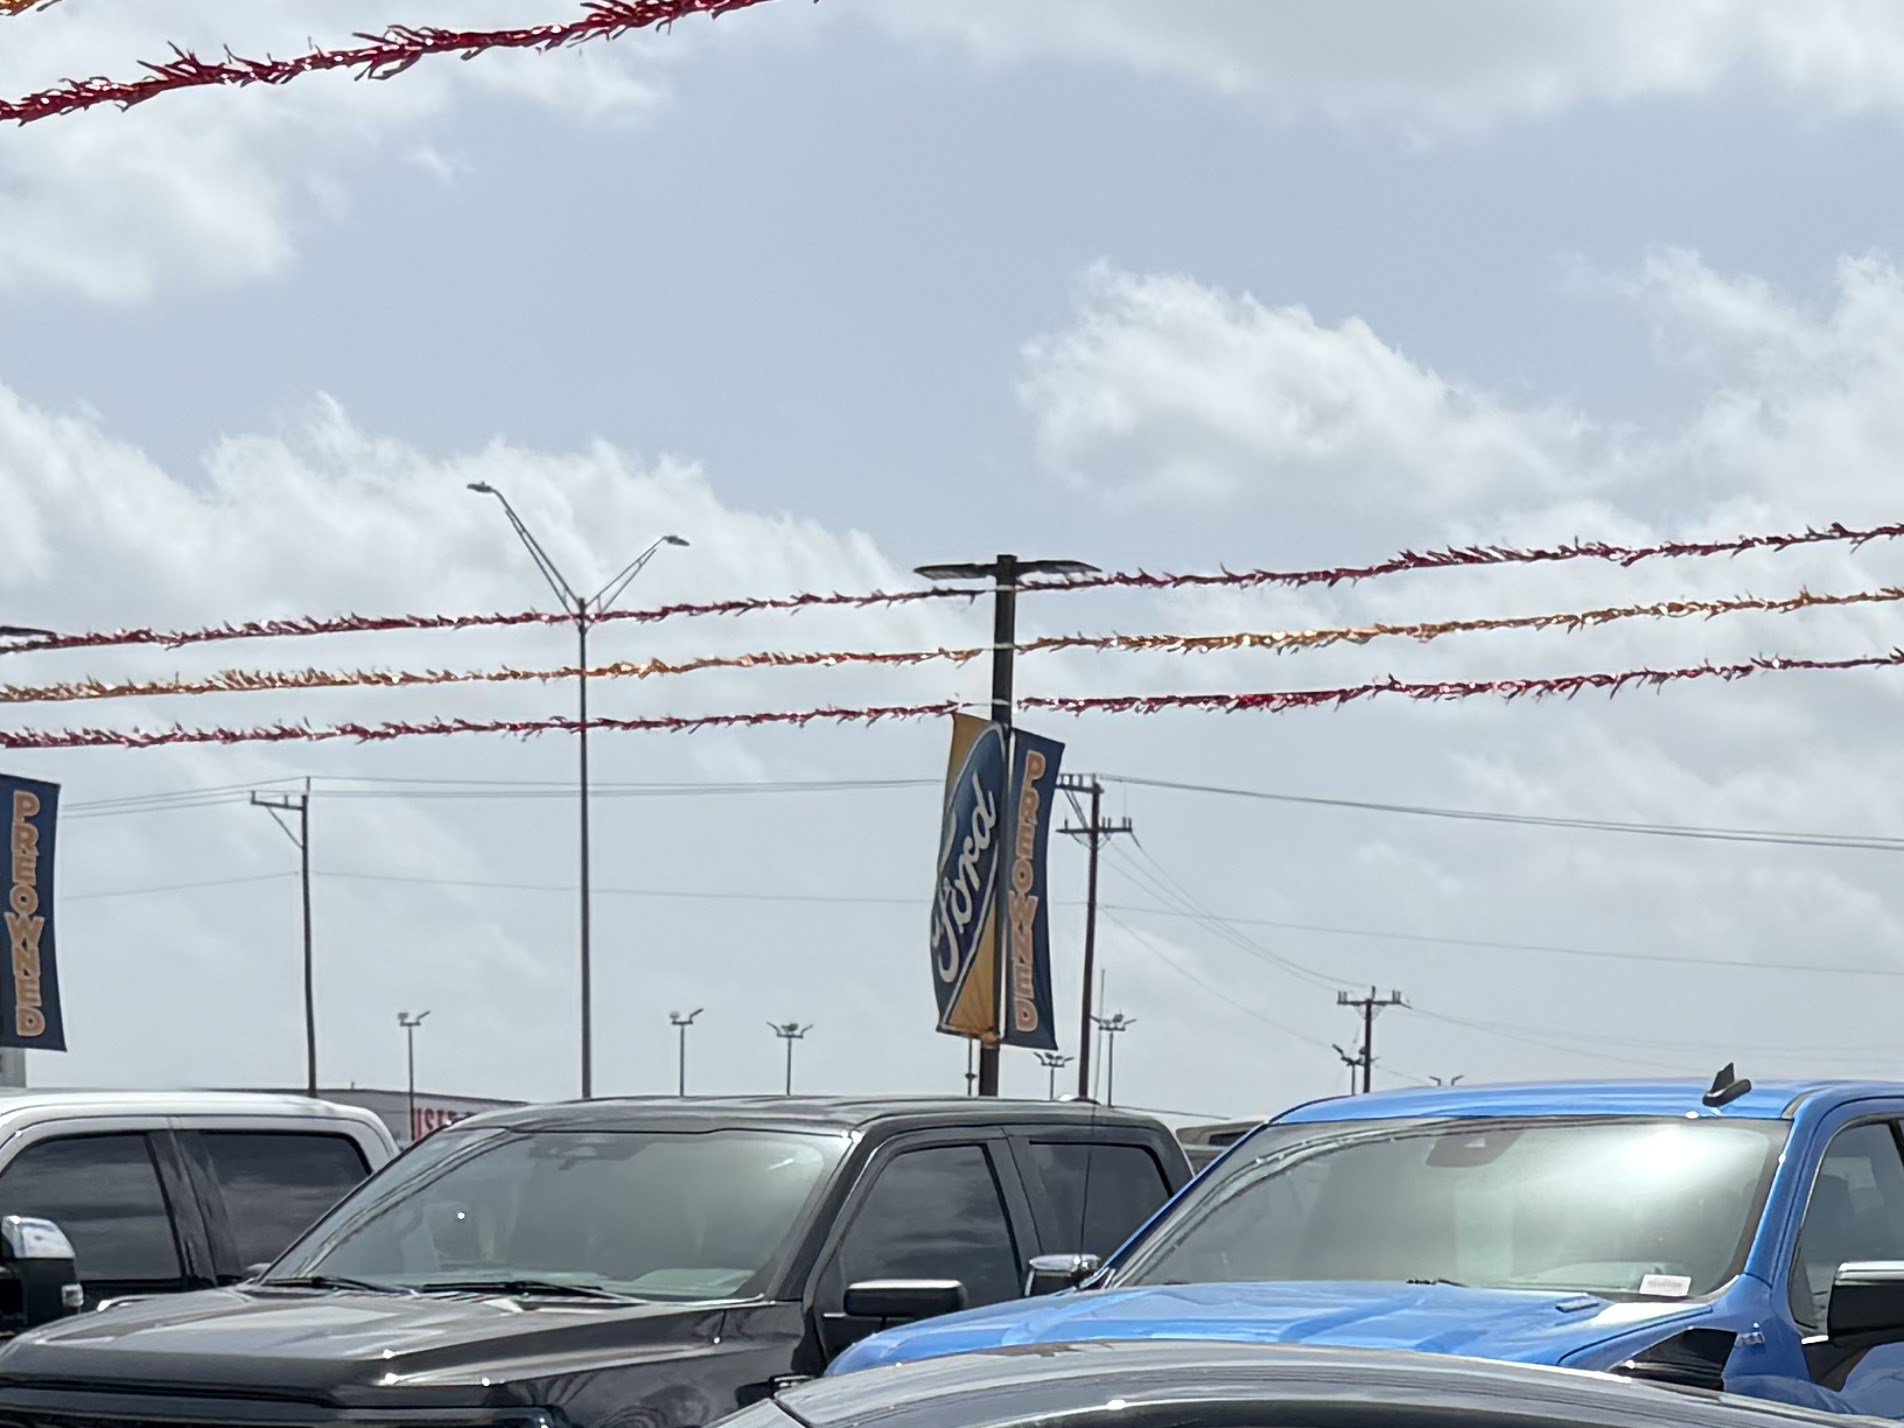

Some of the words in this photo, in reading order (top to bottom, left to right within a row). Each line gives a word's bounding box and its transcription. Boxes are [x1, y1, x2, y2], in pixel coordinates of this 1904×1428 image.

[3, 790, 46, 1037] PREOWNED
[931, 771, 997, 983] Ford
[1007, 750, 1047, 1033] PREOWNED
